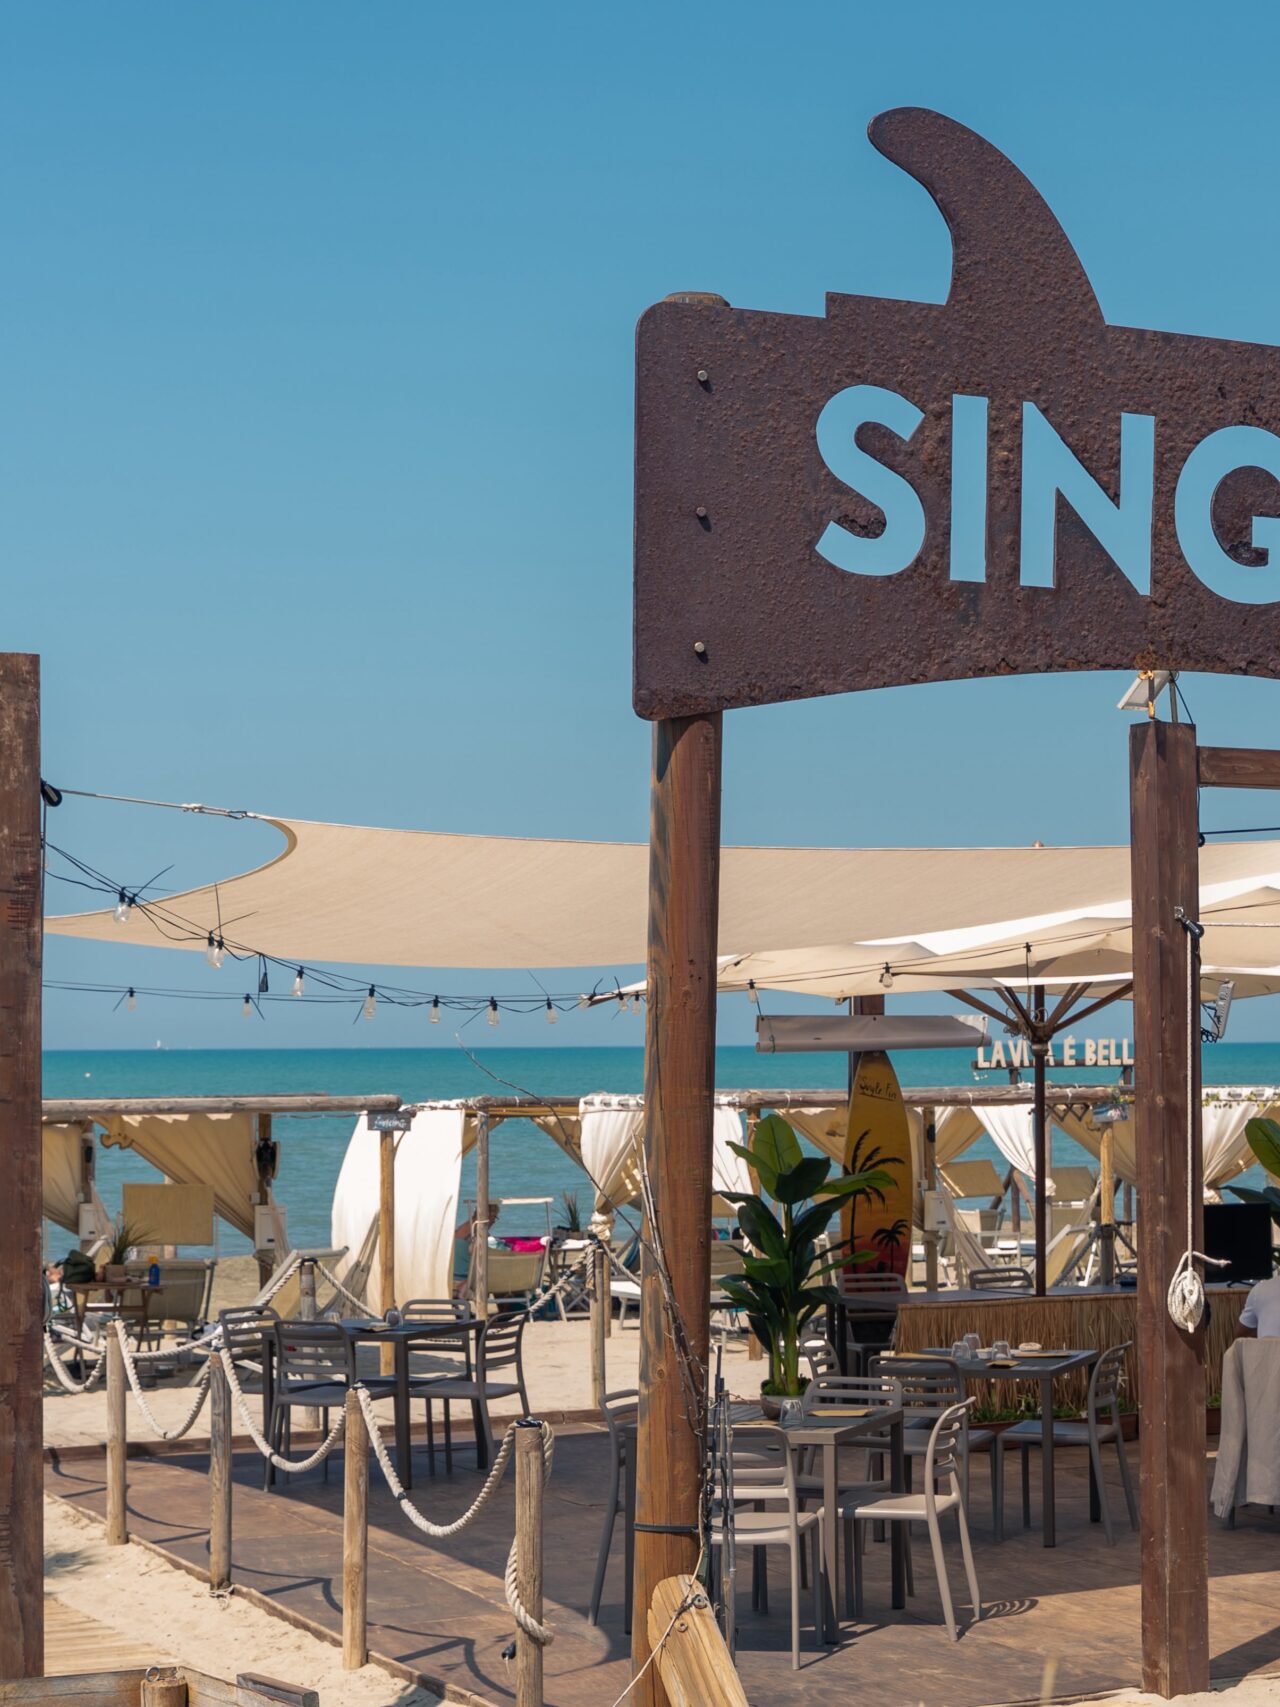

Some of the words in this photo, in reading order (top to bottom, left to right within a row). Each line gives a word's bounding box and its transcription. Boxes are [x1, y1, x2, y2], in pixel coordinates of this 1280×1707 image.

[1008, 1039, 1055, 1067] VIA
[1063, 1035, 1077, 1066] É
[1085, 1038, 1134, 1067] BELL
